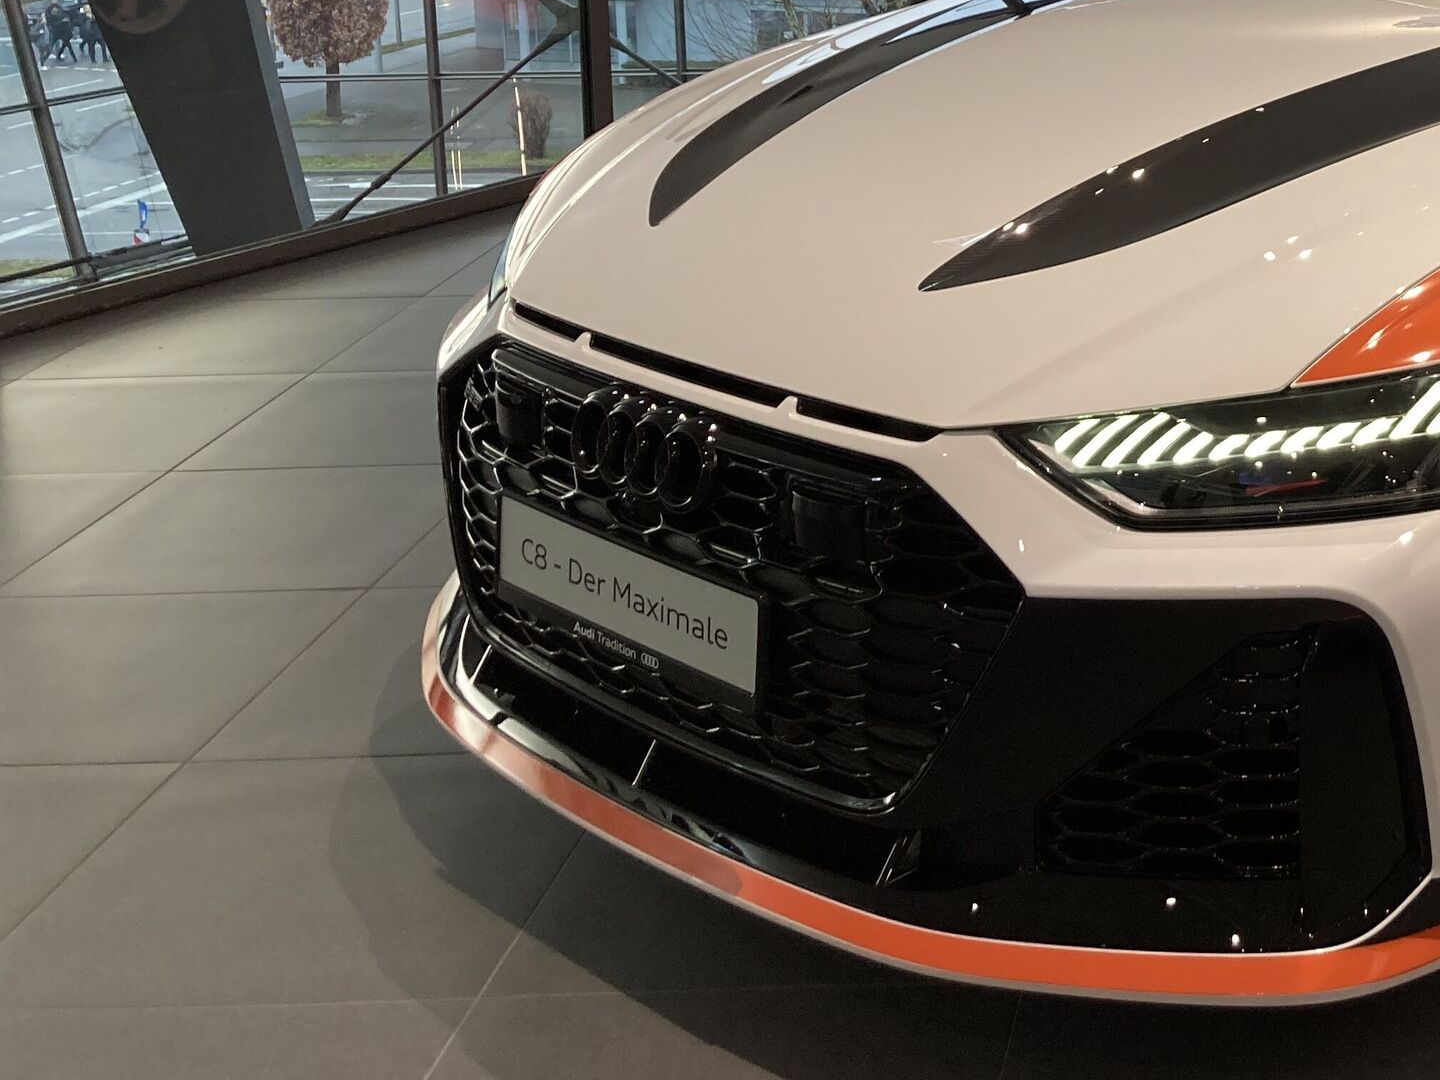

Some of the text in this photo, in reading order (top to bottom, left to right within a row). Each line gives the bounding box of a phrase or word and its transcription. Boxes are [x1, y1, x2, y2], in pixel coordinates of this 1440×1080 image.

[521, 538, 547, 570] C8
[568, 557, 606, 595] Der
[613, 576, 729, 650] Maximale
[572, 621, 637, 660] Audi Tradition
